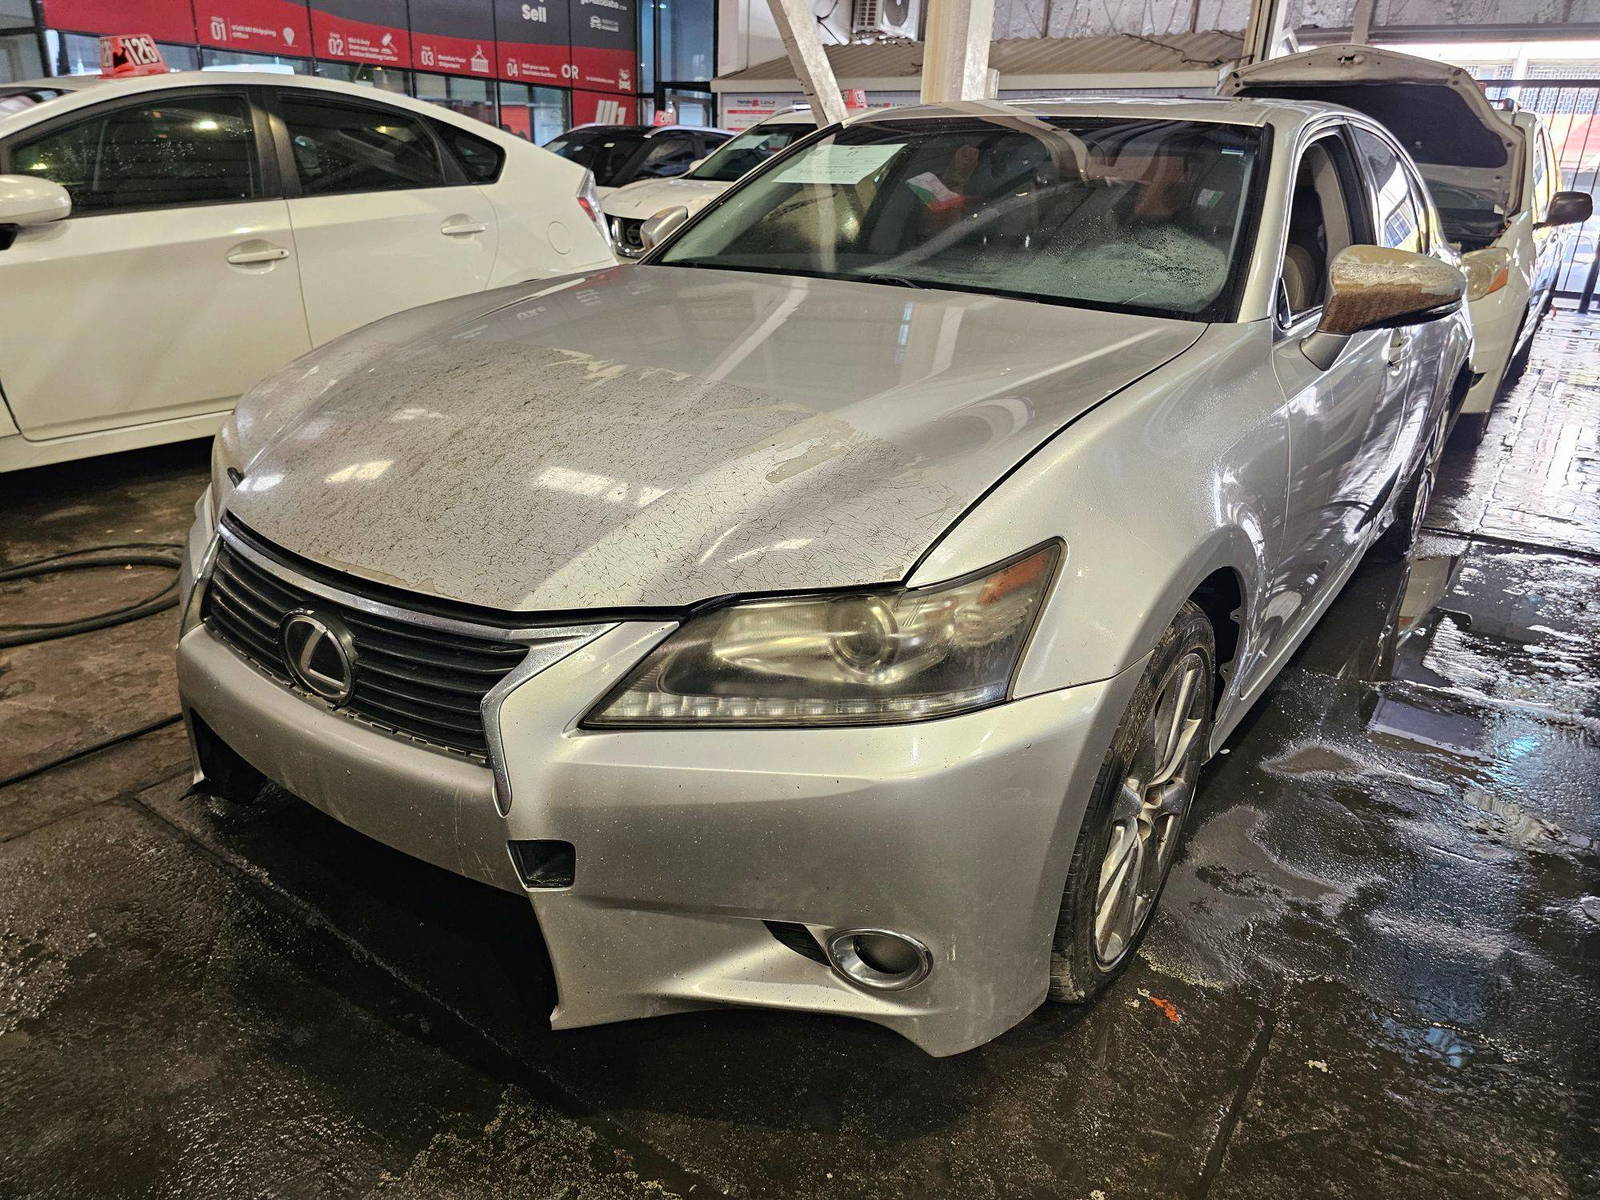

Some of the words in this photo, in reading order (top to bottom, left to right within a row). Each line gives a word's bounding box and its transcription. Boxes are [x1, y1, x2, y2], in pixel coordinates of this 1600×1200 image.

[521, 4, 547, 23] Sell
[211, 21, 227, 41] 01
[124, 37, 160, 65] 126
[328, 37, 345, 56] 02
[421, 50, 435, 66] 03
[506, 62, 519, 77] 04
[561, 64, 579, 80] OR
